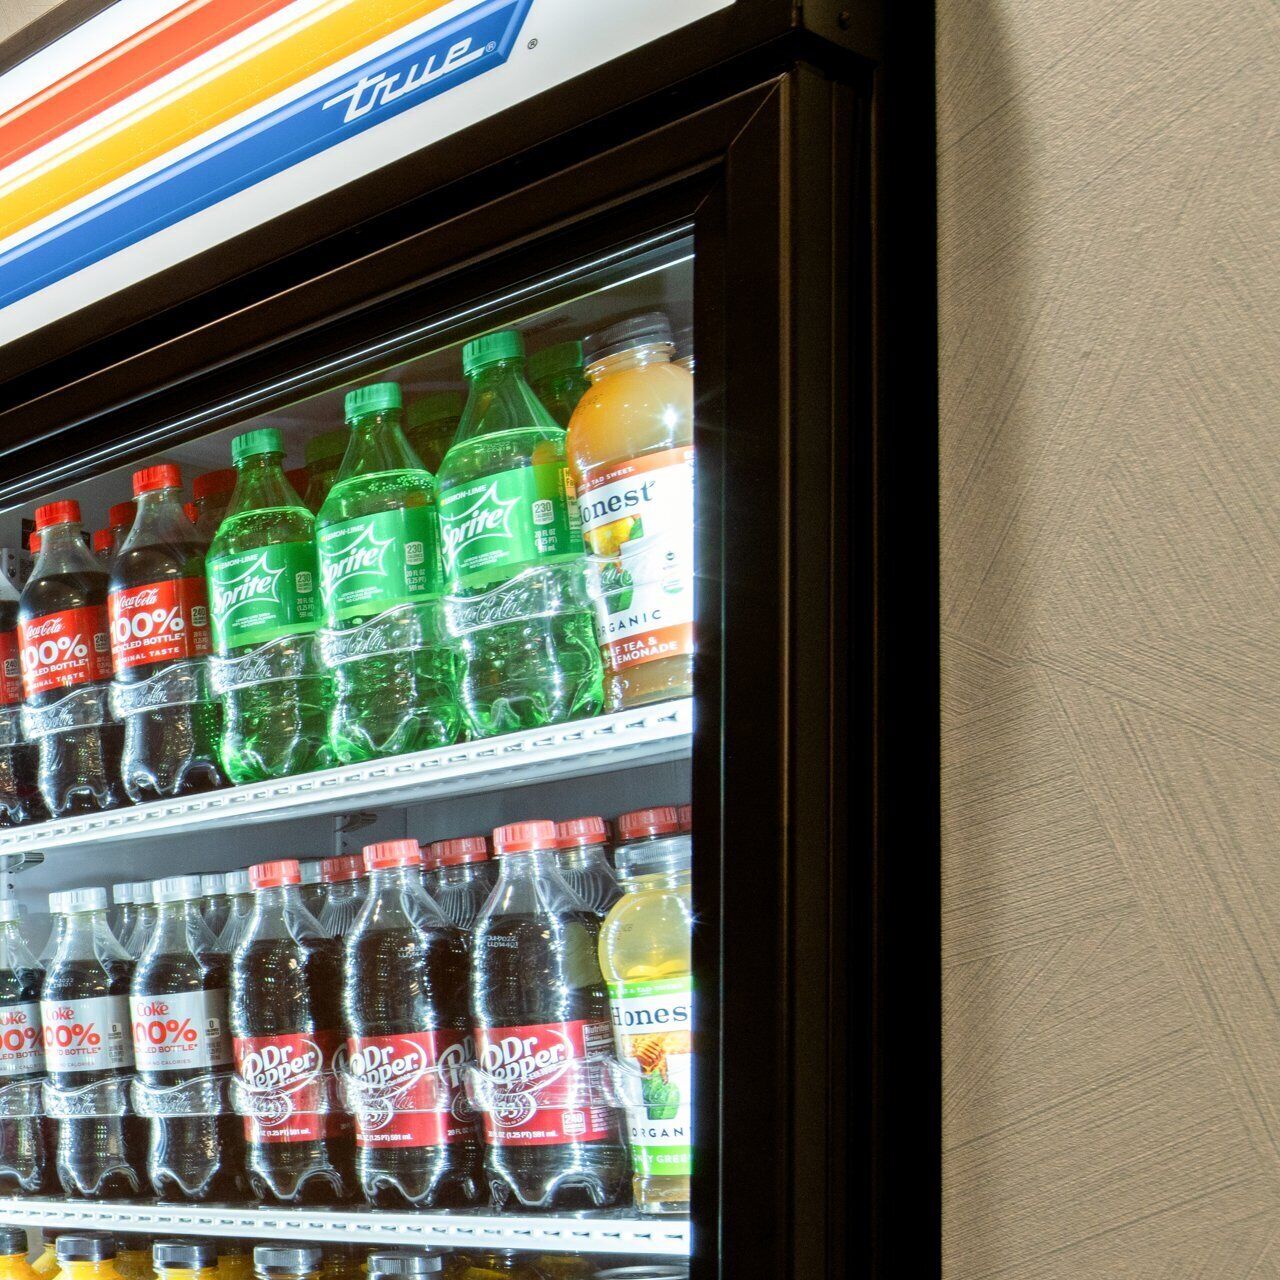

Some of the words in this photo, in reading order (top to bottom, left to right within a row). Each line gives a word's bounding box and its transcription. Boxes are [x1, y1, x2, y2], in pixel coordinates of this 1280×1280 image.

[322, 37, 485, 122] true
[443, 484, 487, 505] LEMON-LIME
[534, 502, 552, 515] 230
[324, 523, 367, 540] LEMON-LIME
[441, 503, 504, 547] Sprite
[218, 553, 259, 570] LEMON-LIME
[406, 544, 423, 556] 230
[320, 544, 380, 585] Sprite
[297, 572, 312, 584] 230
[214, 572, 272, 612] Sprite
[111, 606, 185, 643] 100%
[192, 607, 206, 618] 240
[614, 641, 678, 666] LEMONADE
[137, 1002, 169, 1018] Coke
[260, 1045, 293, 1068] Dr
[361, 1045, 394, 1068] Dr
[500, 1035, 538, 1060] Dr
[242, 1052, 316, 1092] Pepper
[350, 1052, 419, 1088] Pepper
[481, 1043, 566, 1088] Pepper
